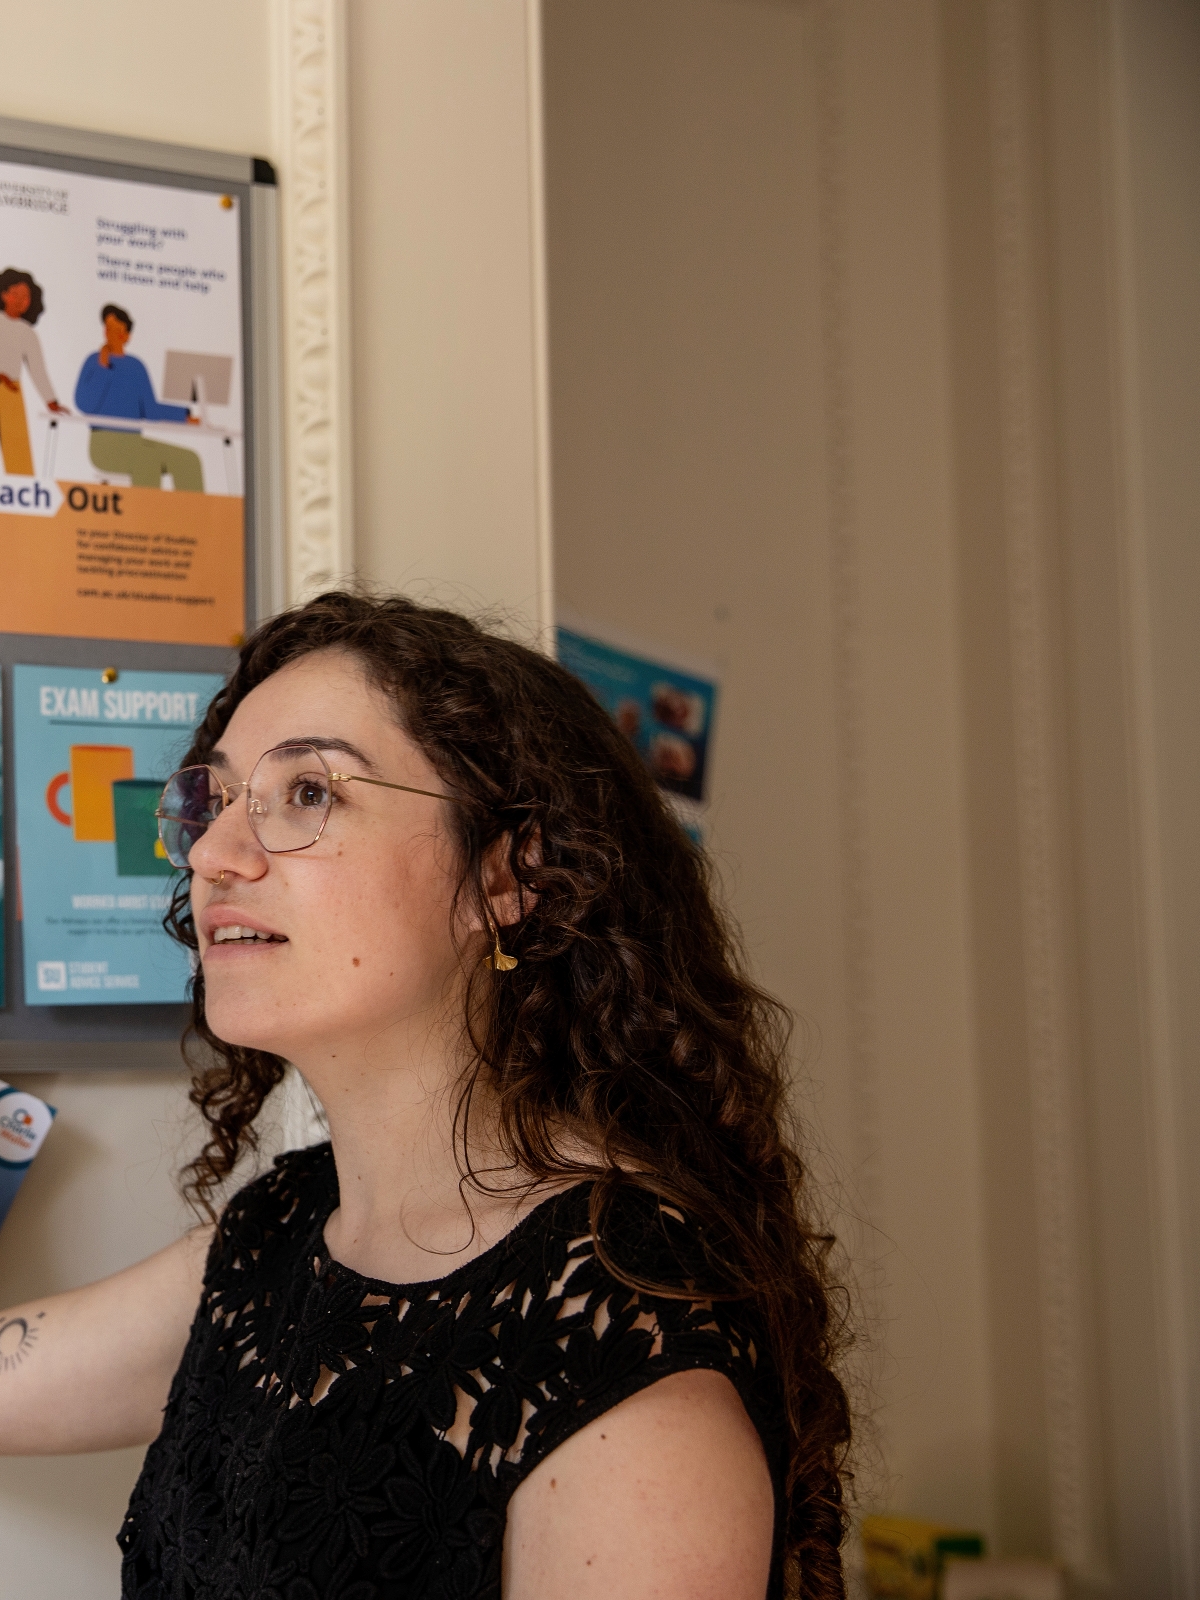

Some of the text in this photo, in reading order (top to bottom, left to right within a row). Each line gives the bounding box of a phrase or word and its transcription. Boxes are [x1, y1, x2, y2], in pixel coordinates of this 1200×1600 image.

[97, 217, 186, 240] Struggling with
[97, 234, 162, 251] your work?
[97, 252, 226, 282] There are people who
[97, 270, 210, 295] will listen and help
[68, 485, 123, 515] Out
[94, 541, 147, 554] confidential
[113, 530, 148, 541] Director
[164, 535, 197, 546] Studies
[40, 686, 198, 722] EXAM SUPPORT
[0, 1115, 37, 1141] Charlie
[1, 1128, 31, 1150] Waller
